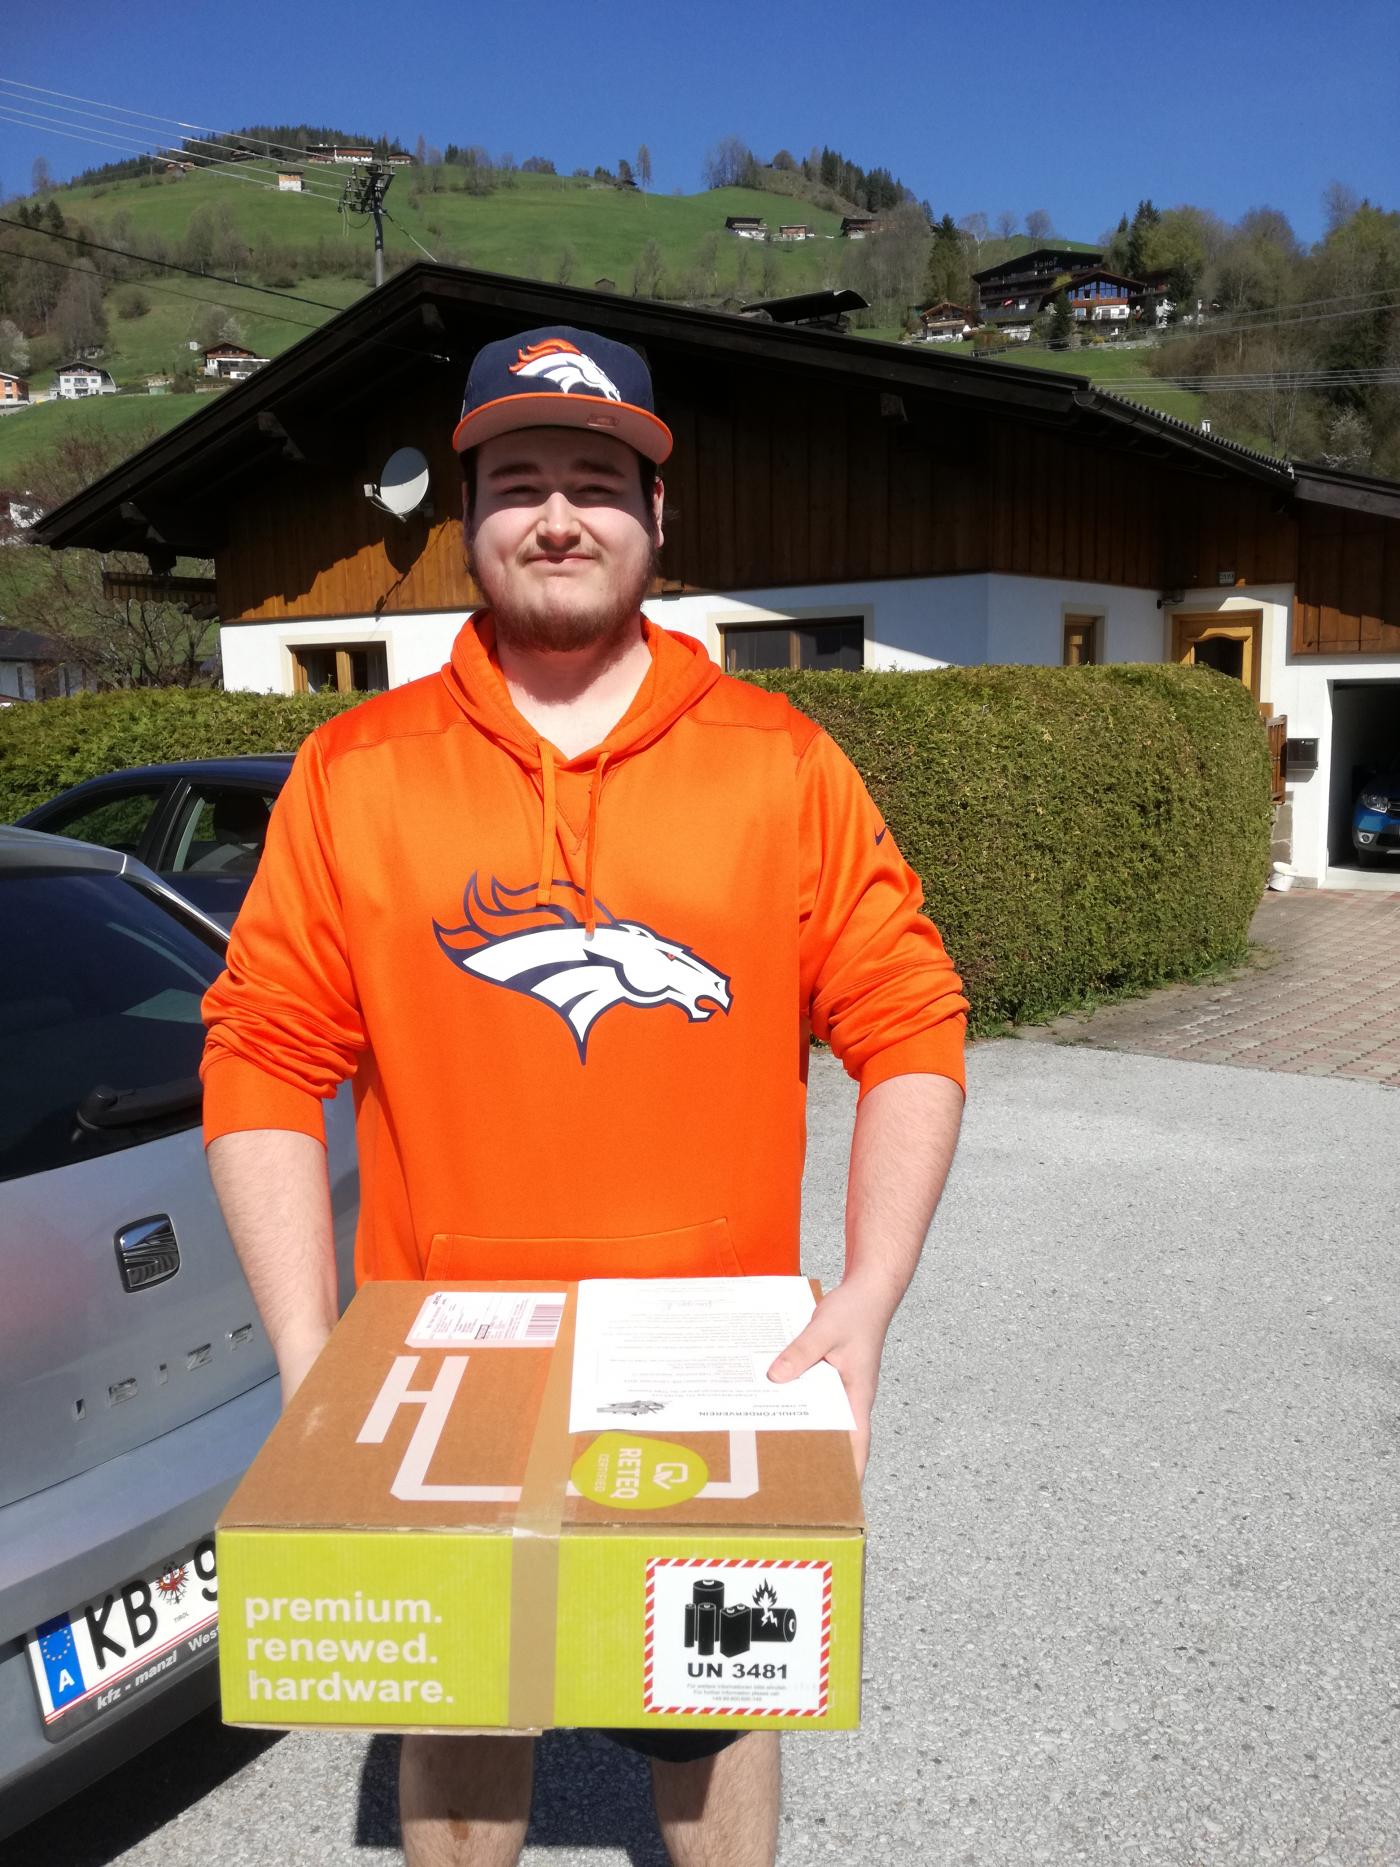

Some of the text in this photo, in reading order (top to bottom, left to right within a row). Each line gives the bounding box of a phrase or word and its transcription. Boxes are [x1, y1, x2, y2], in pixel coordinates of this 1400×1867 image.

[73, 1323, 253, 1421] IBIZA
[610, 1448, 642, 1499] RETEQ
[84, 1580, 158, 1669] KB
[174, 1611, 189, 1623] TIROL
[245, 1591, 443, 1629] premium.
[247, 1632, 438, 1664] renewed.
[58, 1669, 75, 1693] A
[97, 1688, 121, 1710] kfz
[135, 1650, 177, 1686] manzl
[248, 1670, 454, 1704] hardware.
[687, 1662, 787, 1679] UN 3481
